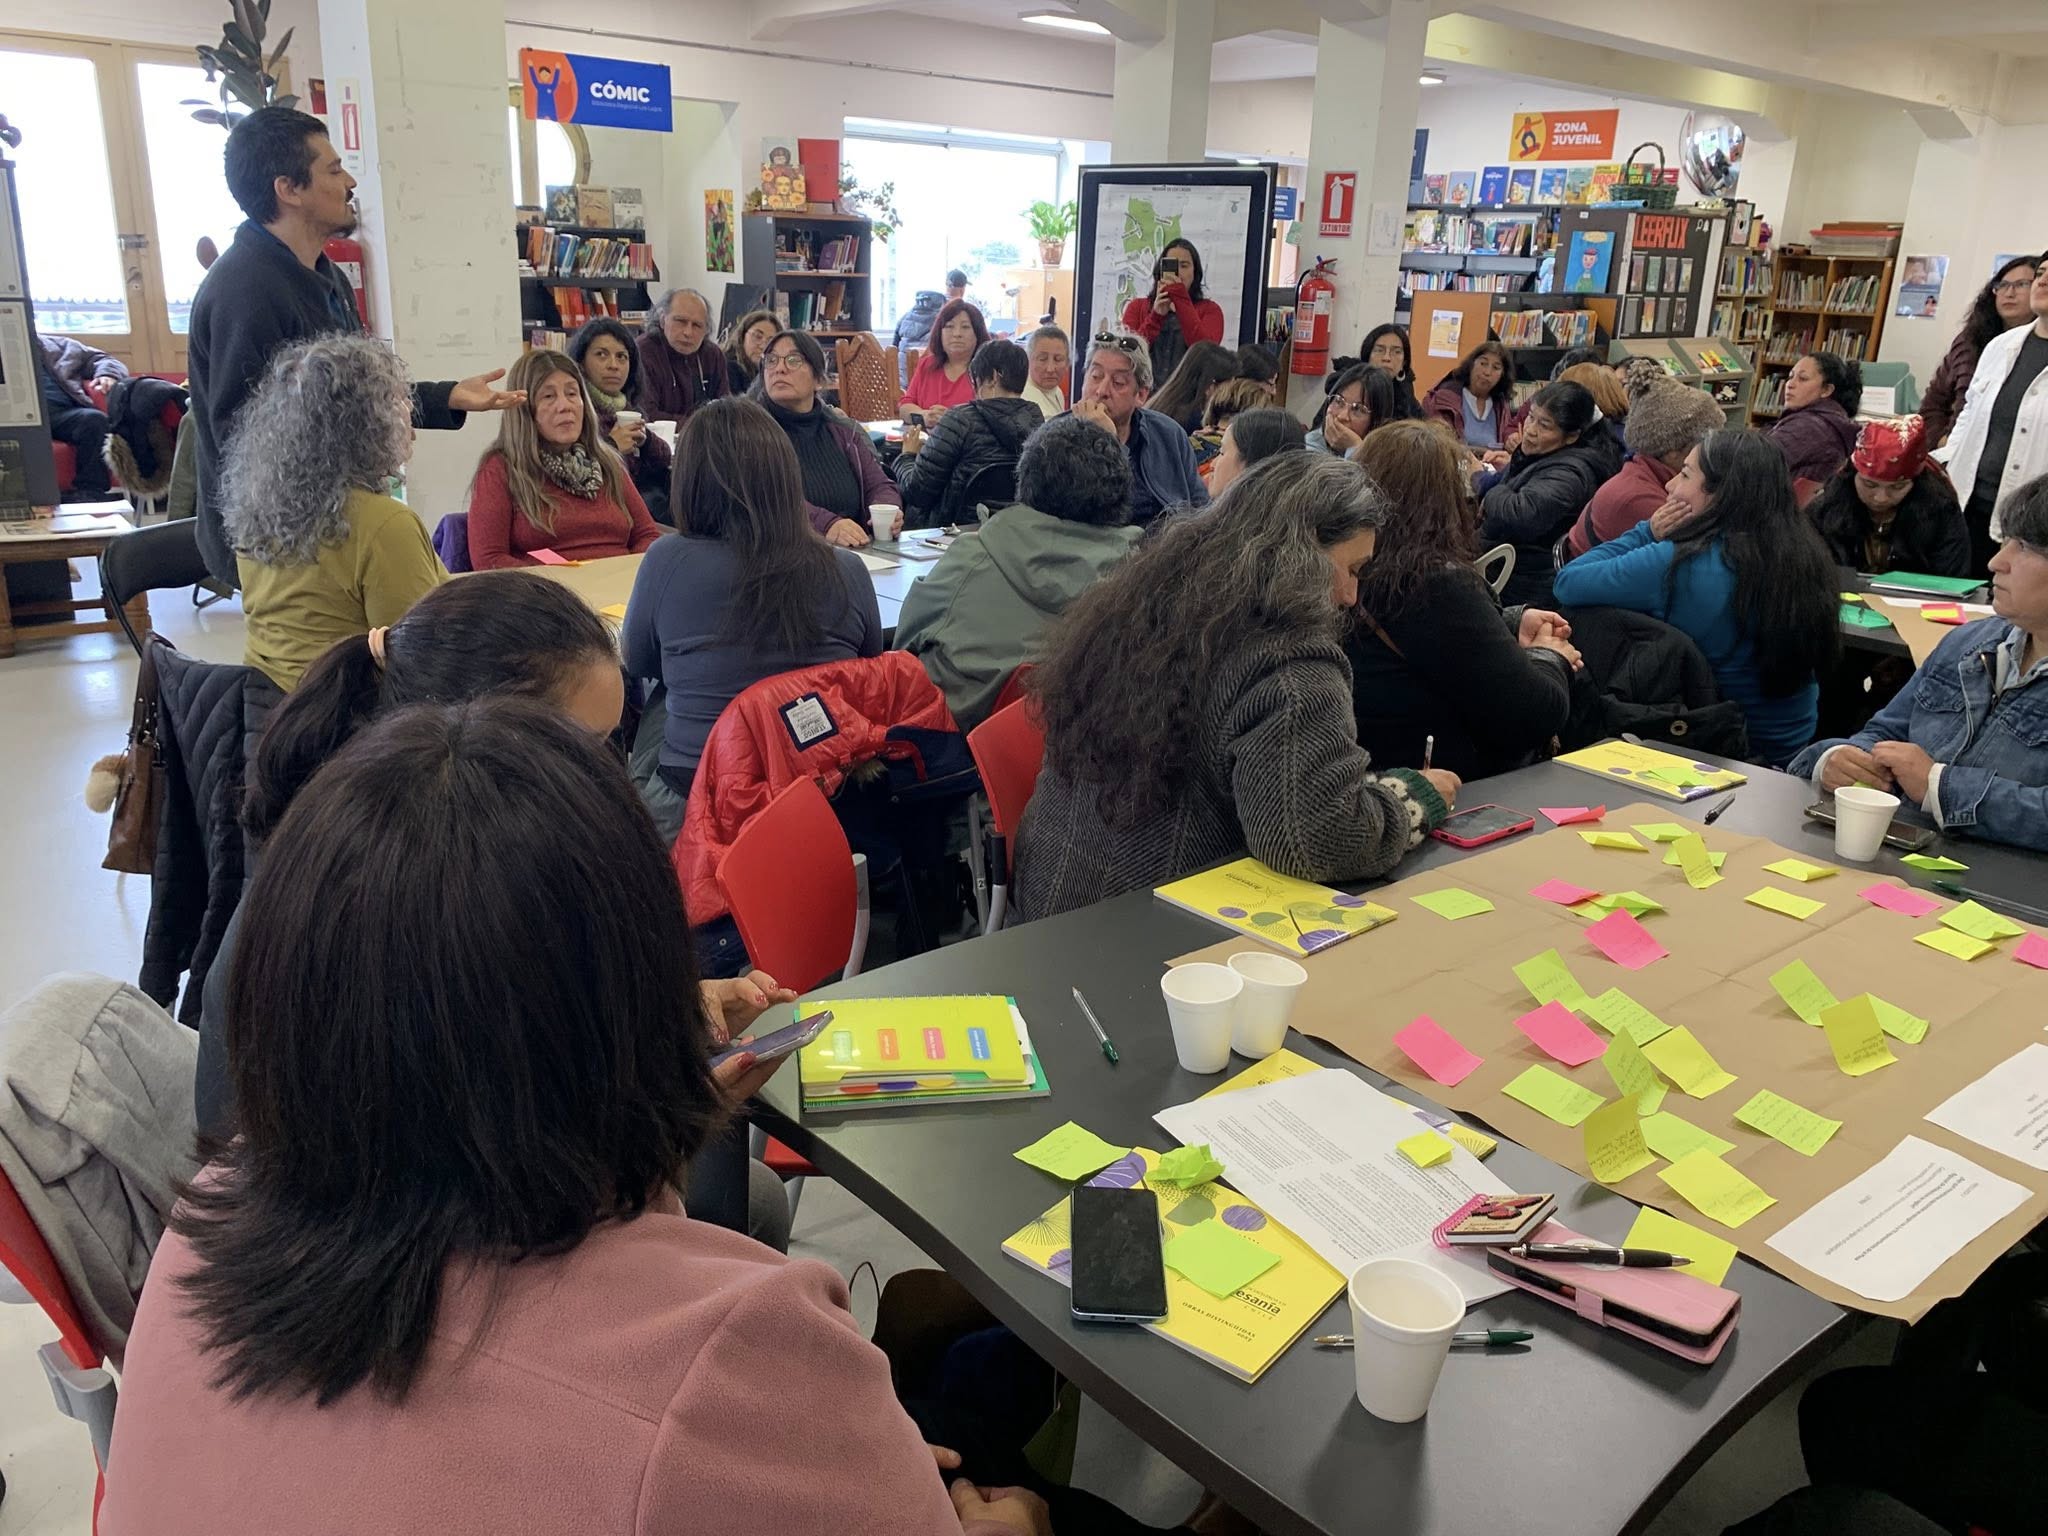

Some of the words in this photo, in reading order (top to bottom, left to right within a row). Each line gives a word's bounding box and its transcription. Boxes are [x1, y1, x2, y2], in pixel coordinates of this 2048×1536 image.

[590, 80, 650, 103] CÓMIC
[1554, 122, 1588, 133] ZONA
[1552, 134, 1602, 145] JUVENIL
[1320, 223, 1351, 232] EXTINTOR
[1632, 215, 1689, 249] LEERFLIX
[1235, 1289, 1281, 1315] esanía
[1182, 1302, 1205, 1315] OBRAS
[1205, 1312, 1256, 1338] DISTINGUIDAS
